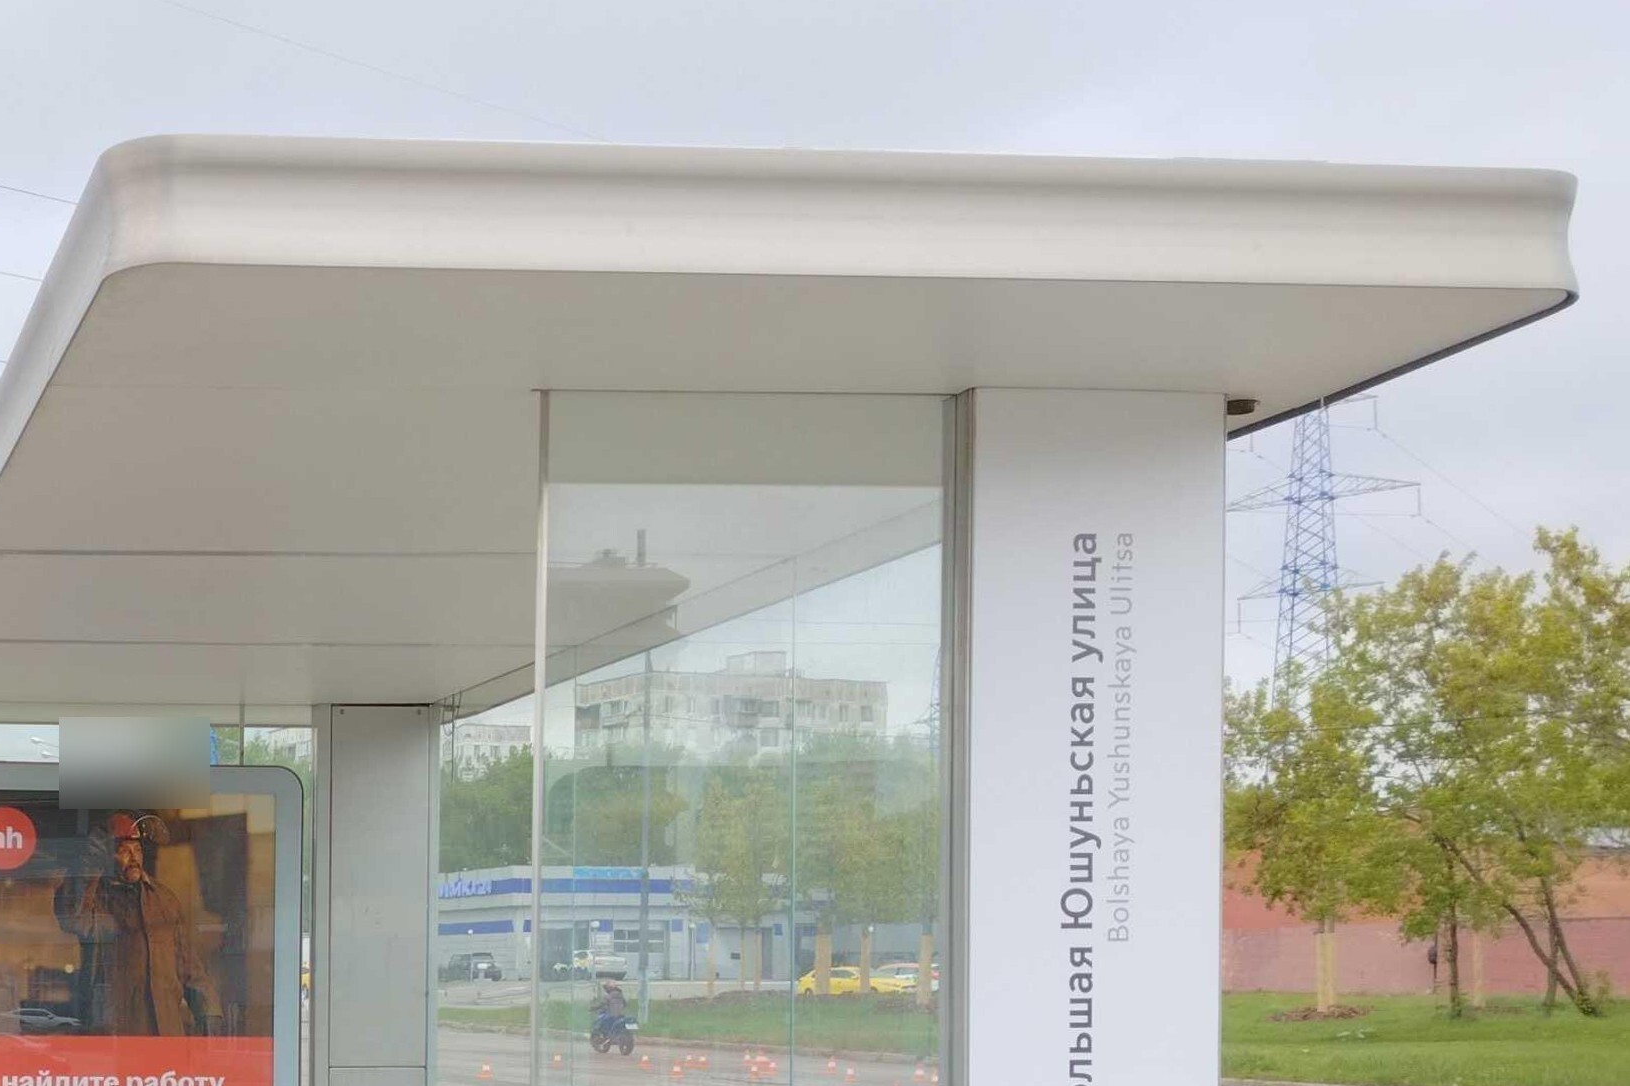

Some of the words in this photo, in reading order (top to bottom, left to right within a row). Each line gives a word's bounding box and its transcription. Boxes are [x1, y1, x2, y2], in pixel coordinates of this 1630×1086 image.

[1071, 533, 1104, 664] улица
[1110, 533, 1134, 615] Ulitsa
[1106, 625, 1137, 809] Yushunskaya
[1059, 677, 1102, 930] Юшуньская
[1106, 816, 1135, 942] Bolshaya
